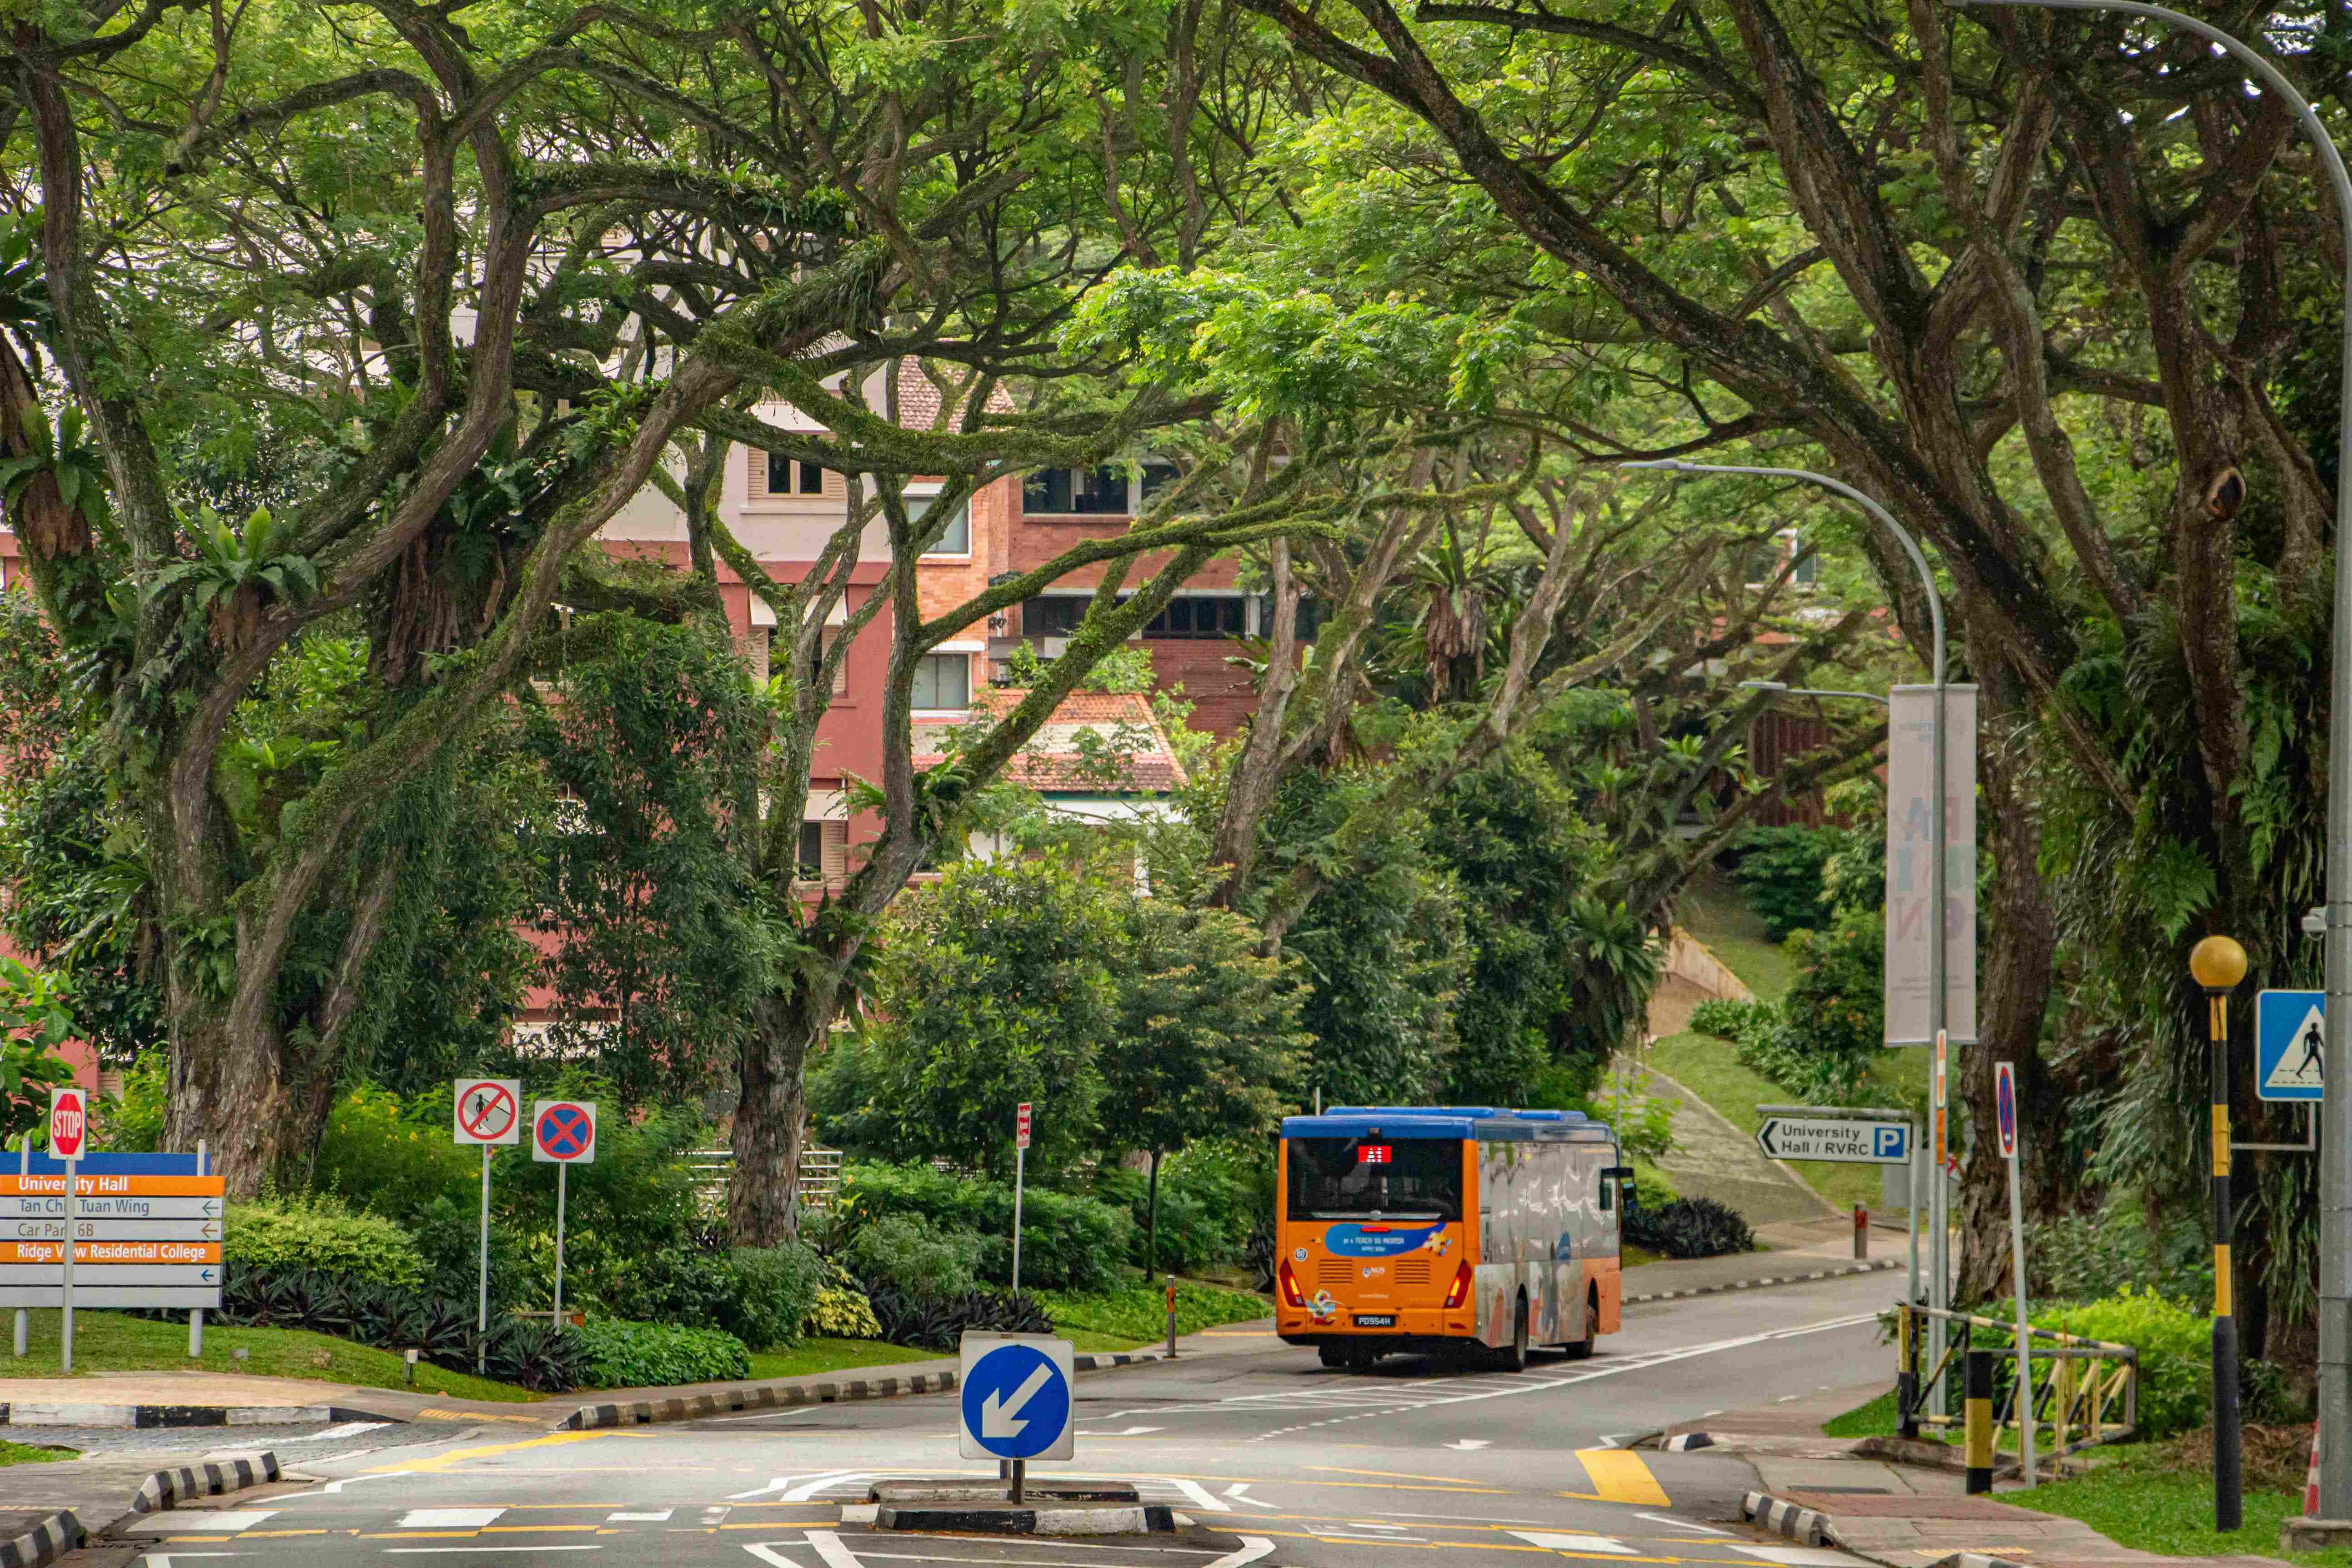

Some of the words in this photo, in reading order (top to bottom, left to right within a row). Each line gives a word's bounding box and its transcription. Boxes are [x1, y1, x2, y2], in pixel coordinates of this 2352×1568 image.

[54, 1110, 81, 1138] STOP
[1782, 1124, 1861, 1142] University
[1782, 1141, 1810, 1153] Hall
[1825, 1142, 1870, 1156] RVRC
[1879, 1129, 1900, 1155] P
[1367, 1146, 1382, 1162] A1
[19, 1176, 95, 1194] Univerity
[99, 1177, 129, 1191] Hall
[19, 1199, 40, 1212] Tan
[45, 1198, 74, 1212] Chi
[80, 1199, 110, 1212] Tuan
[115, 1199, 150, 1216] Wing
[18, 1223, 40, 1237] Car
[45, 1223, 69, 1237] Par
[77, 1223, 94, 1237] 6B
[17, 1243, 52, 1262] Ridge
[55, 1244, 86, 1258] Vw
[90, 1243, 157, 1259] Residential
[160, 1244, 206, 1262] College
